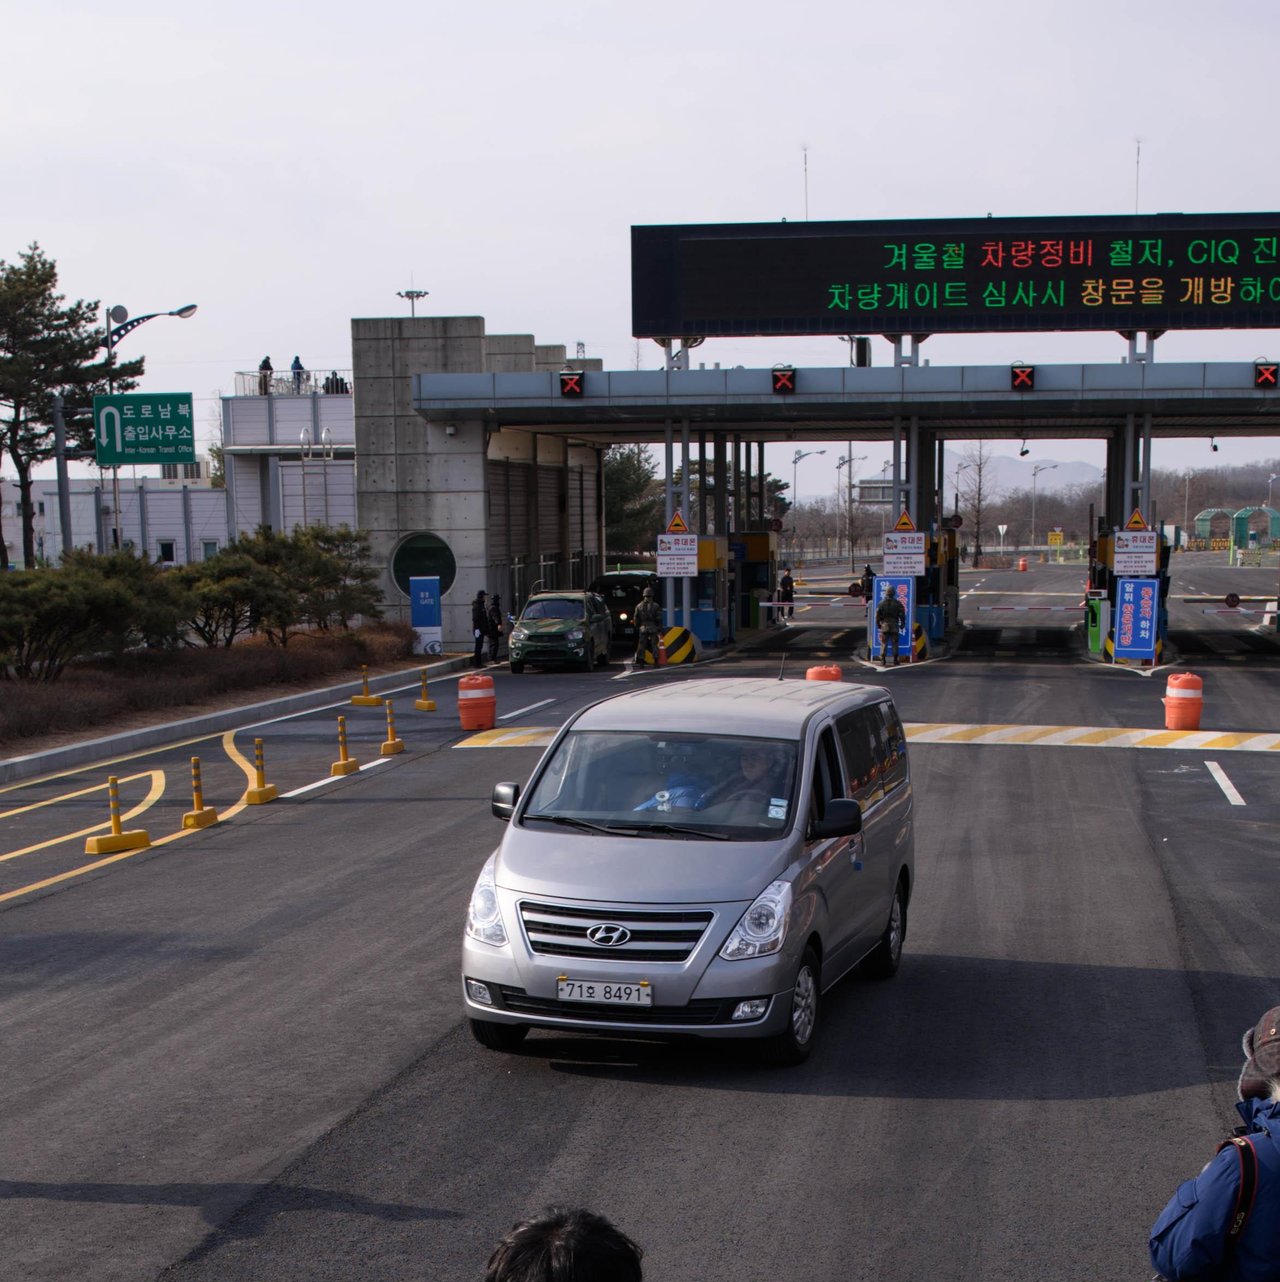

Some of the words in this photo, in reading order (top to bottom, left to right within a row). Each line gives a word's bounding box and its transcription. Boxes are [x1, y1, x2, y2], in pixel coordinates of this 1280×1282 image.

[883, 242, 966, 271] 겨울철
[980, 239, 1093, 269] 차량정비
[1109, 238, 1174, 268] 철저,
[1187, 239, 1240, 266] CIQ
[827, 281, 969, 311] 차량게이트
[982, 279, 1066, 309] 심사시
[1080, 277, 1166, 306] 창문을
[122, 425, 192, 441] 출입사무소
[178, 445, 193, 454] Office
[1139, 586, 1153, 619] 동승자
[1139, 620, 1151, 639] 하차
[566, 983, 596, 998] 71호
[603, 985, 641, 1002] 8491
